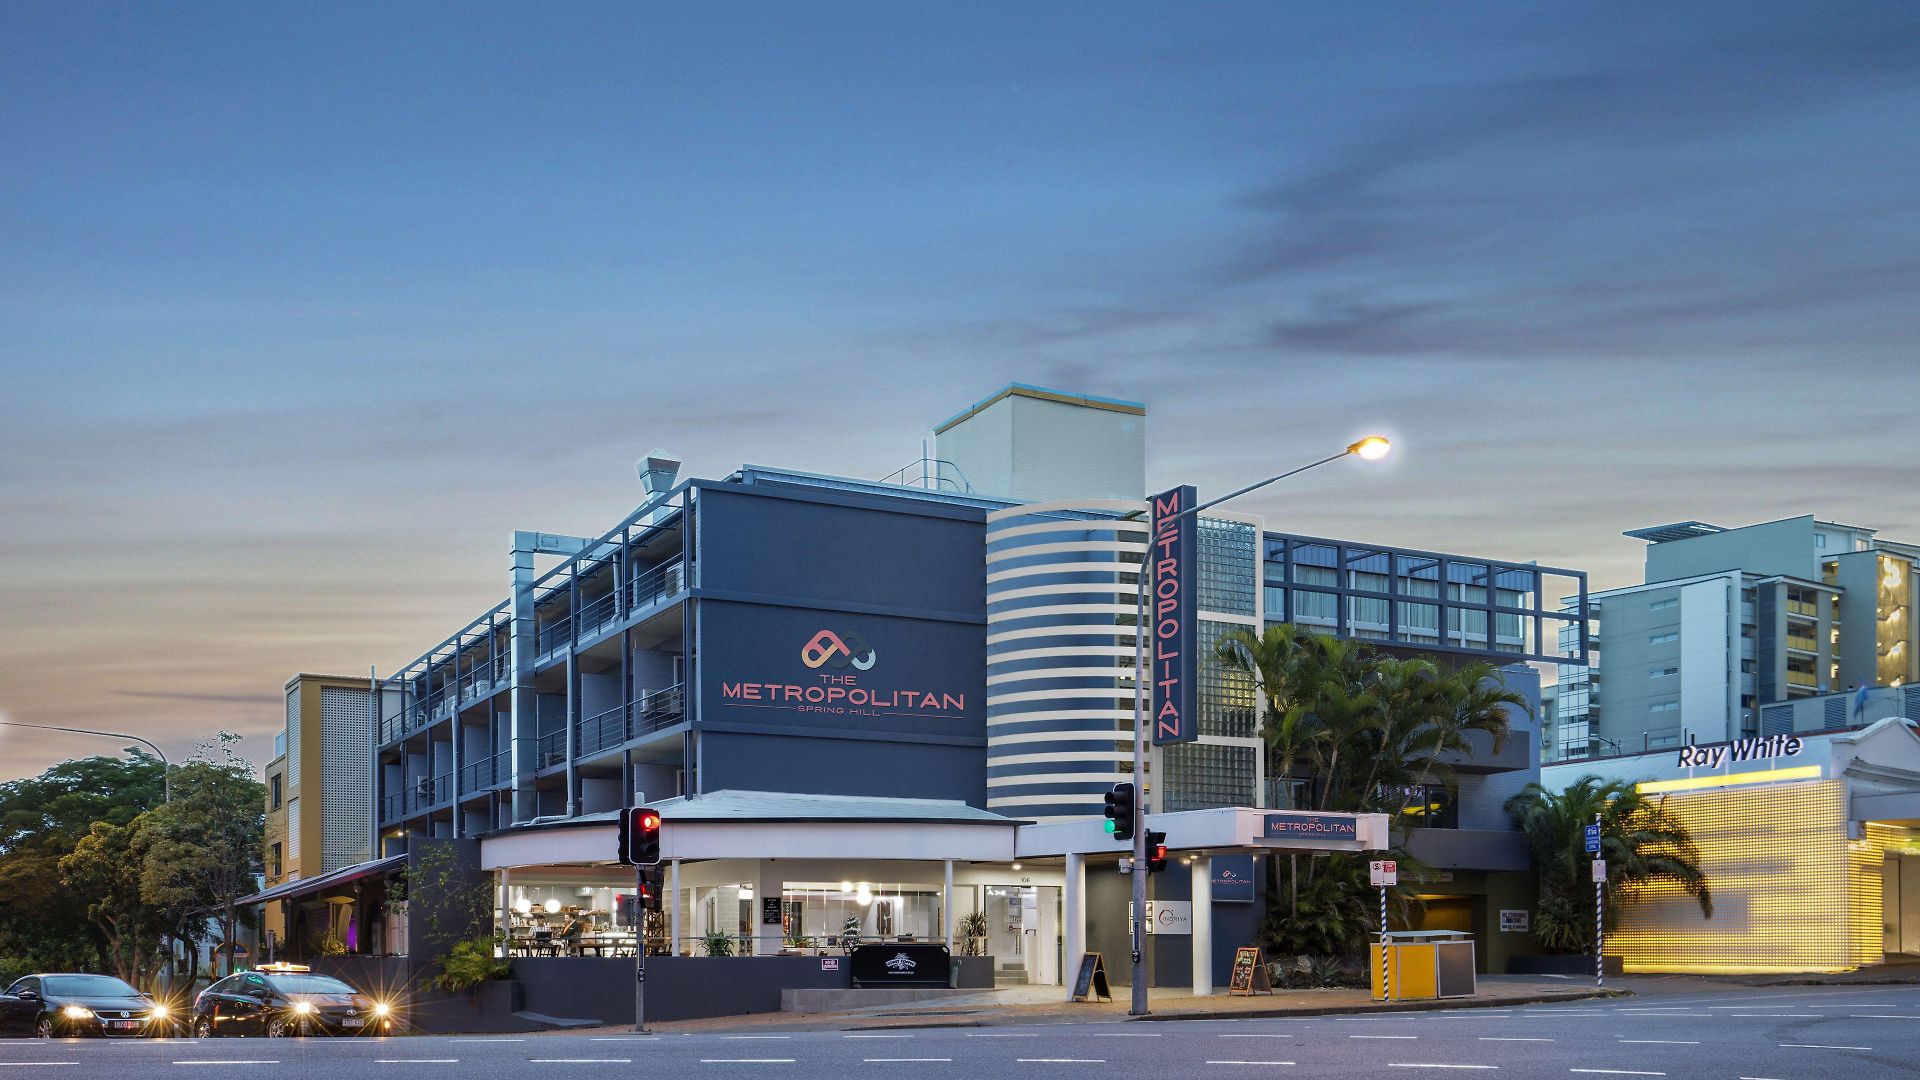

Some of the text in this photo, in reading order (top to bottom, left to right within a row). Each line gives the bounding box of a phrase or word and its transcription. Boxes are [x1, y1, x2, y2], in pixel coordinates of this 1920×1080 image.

[1156, 491, 1179, 739] METROPOLITAN
[819, 674, 857, 686] THE
[722, 682, 965, 711] METROPOLITAN
[797, 705, 881, 717] SPRING HILL
[1677, 734, 1803, 769] Ray White
[1271, 822, 1355, 833] METROPOLITAN
